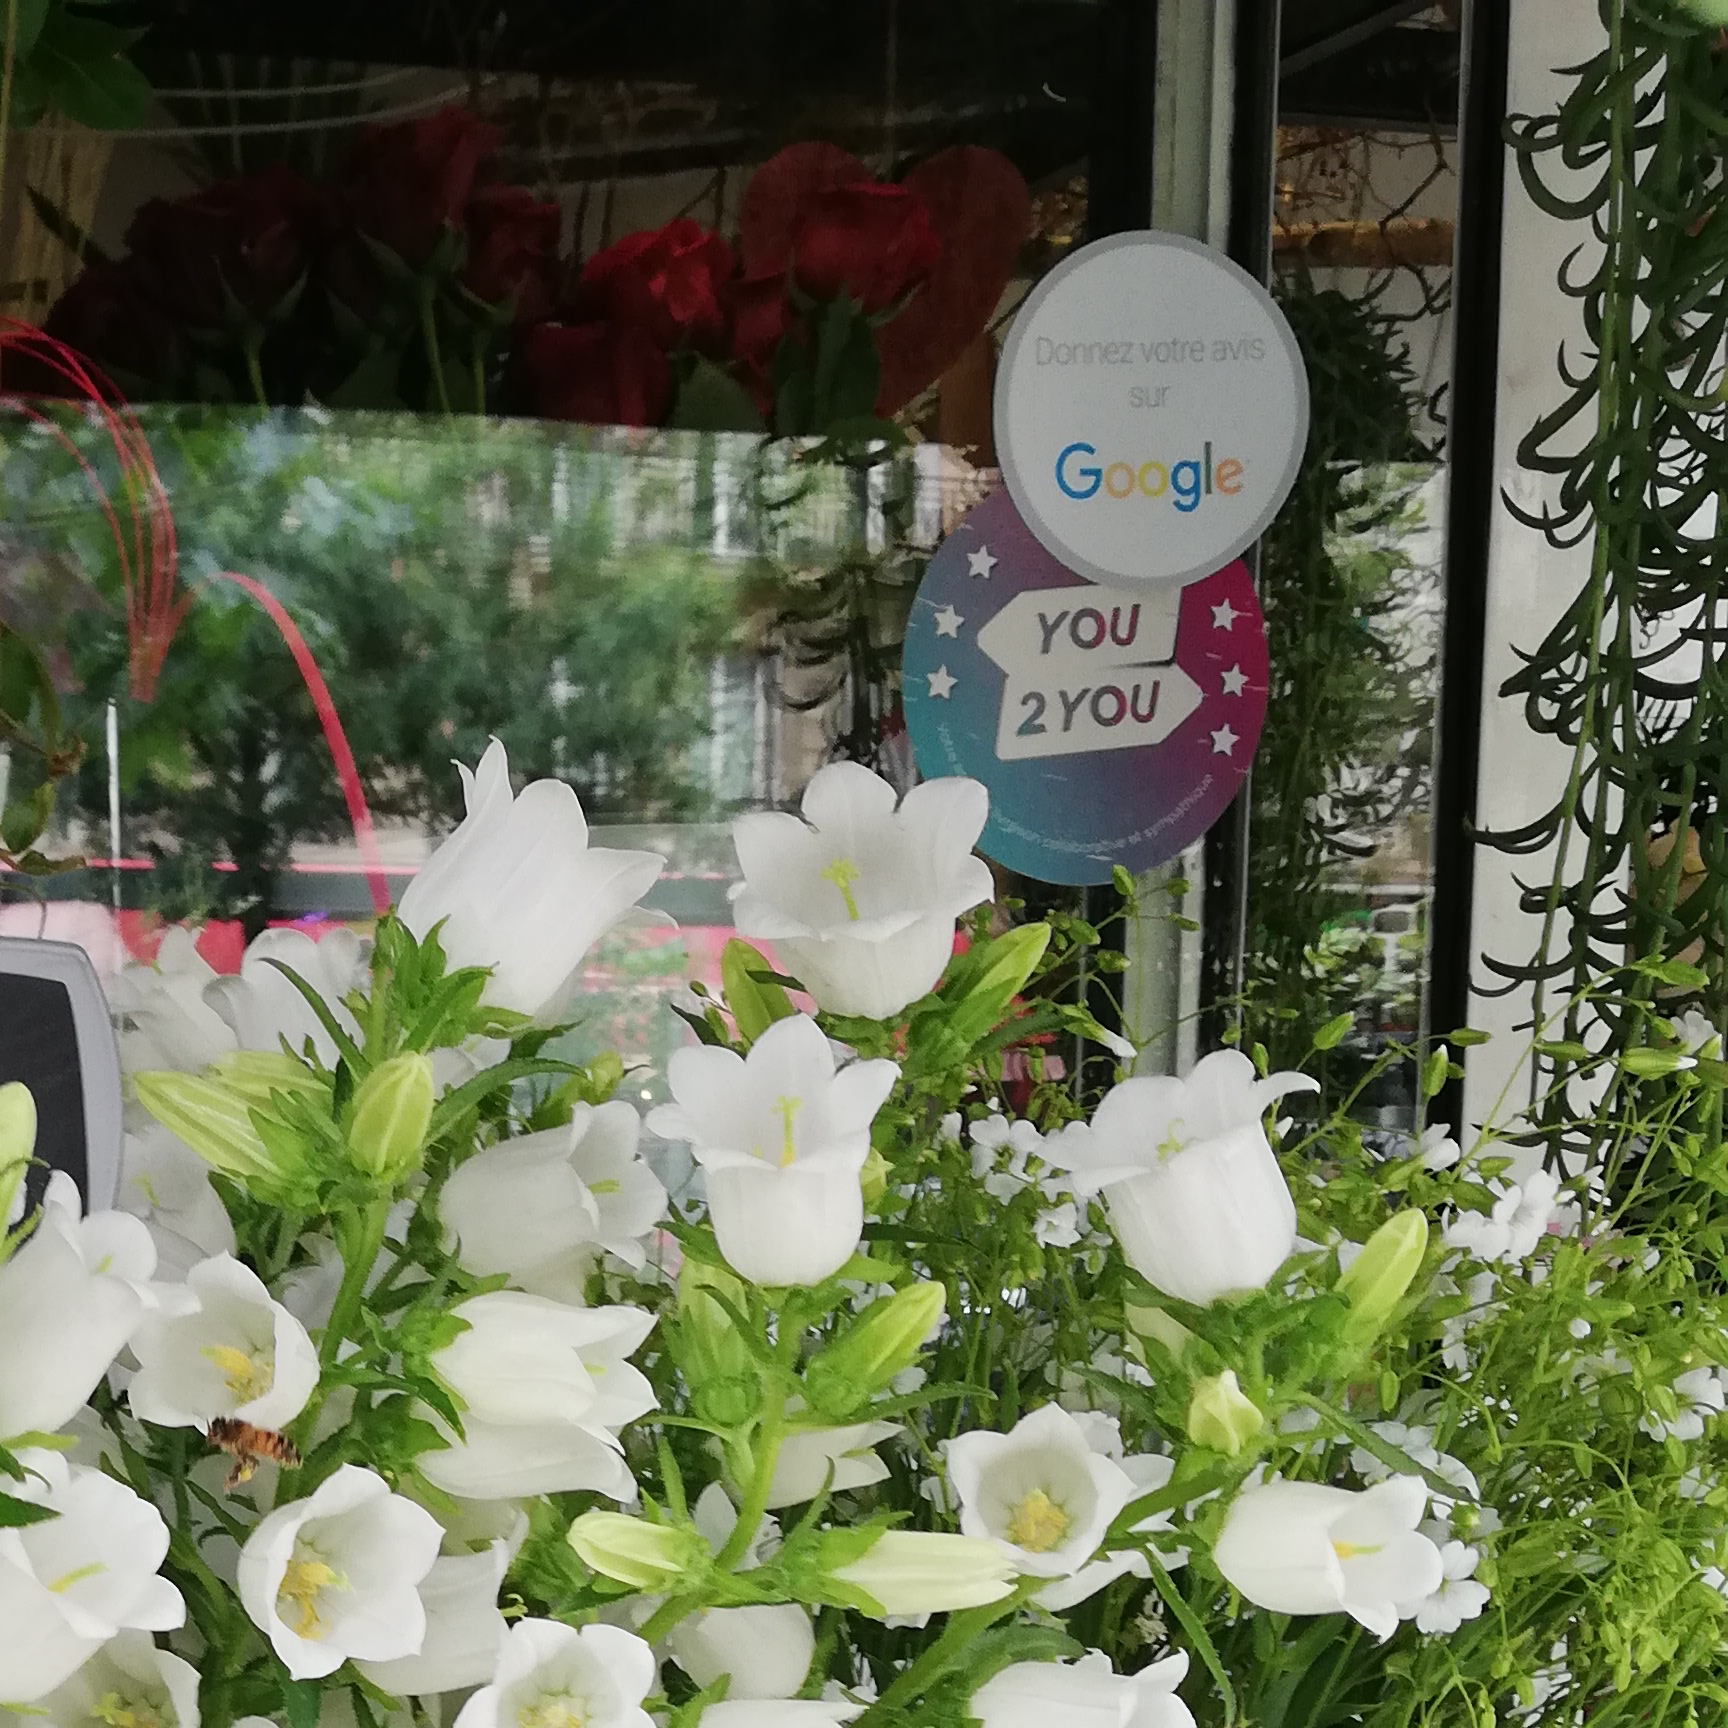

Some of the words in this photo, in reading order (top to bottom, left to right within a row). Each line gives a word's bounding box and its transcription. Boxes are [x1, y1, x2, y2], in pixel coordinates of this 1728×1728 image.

[1035, 336, 1133, 366] Donnez
[1140, 337, 1205, 363] votre
[1212, 336, 1266, 362] avis
[1128, 386, 1170, 408] sur
[1055, 441, 1244, 513] Google
[1037, 603, 1141, 654] YOU
[1016, 680, 1160, 737] 2YOU
